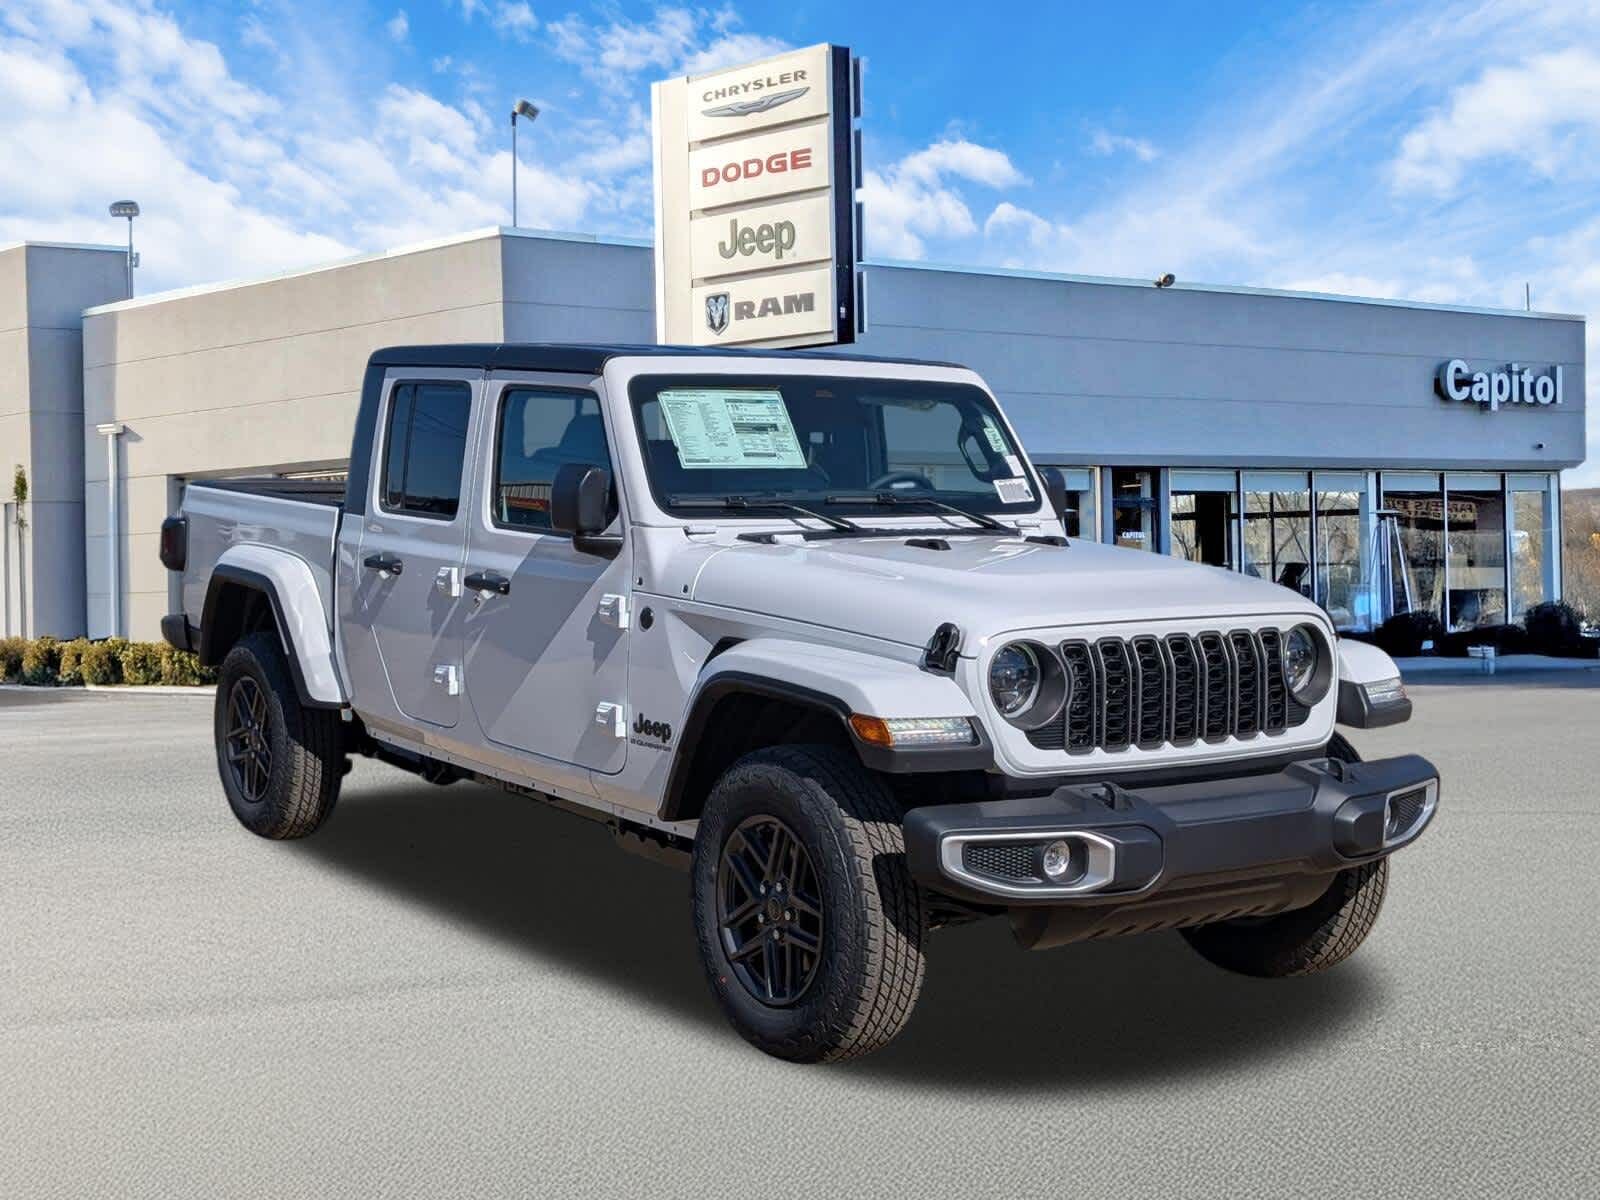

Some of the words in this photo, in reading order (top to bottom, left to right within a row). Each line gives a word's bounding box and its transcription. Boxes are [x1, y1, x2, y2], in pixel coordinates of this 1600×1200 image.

[702, 69, 808, 103] CHRYSLER
[702, 148, 812, 187] DODGE
[718, 218, 796, 259] Jeep
[734, 292, 815, 321] RAM
[1446, 359, 1563, 411] Capitol
[633, 712, 671, 743] Jeep
